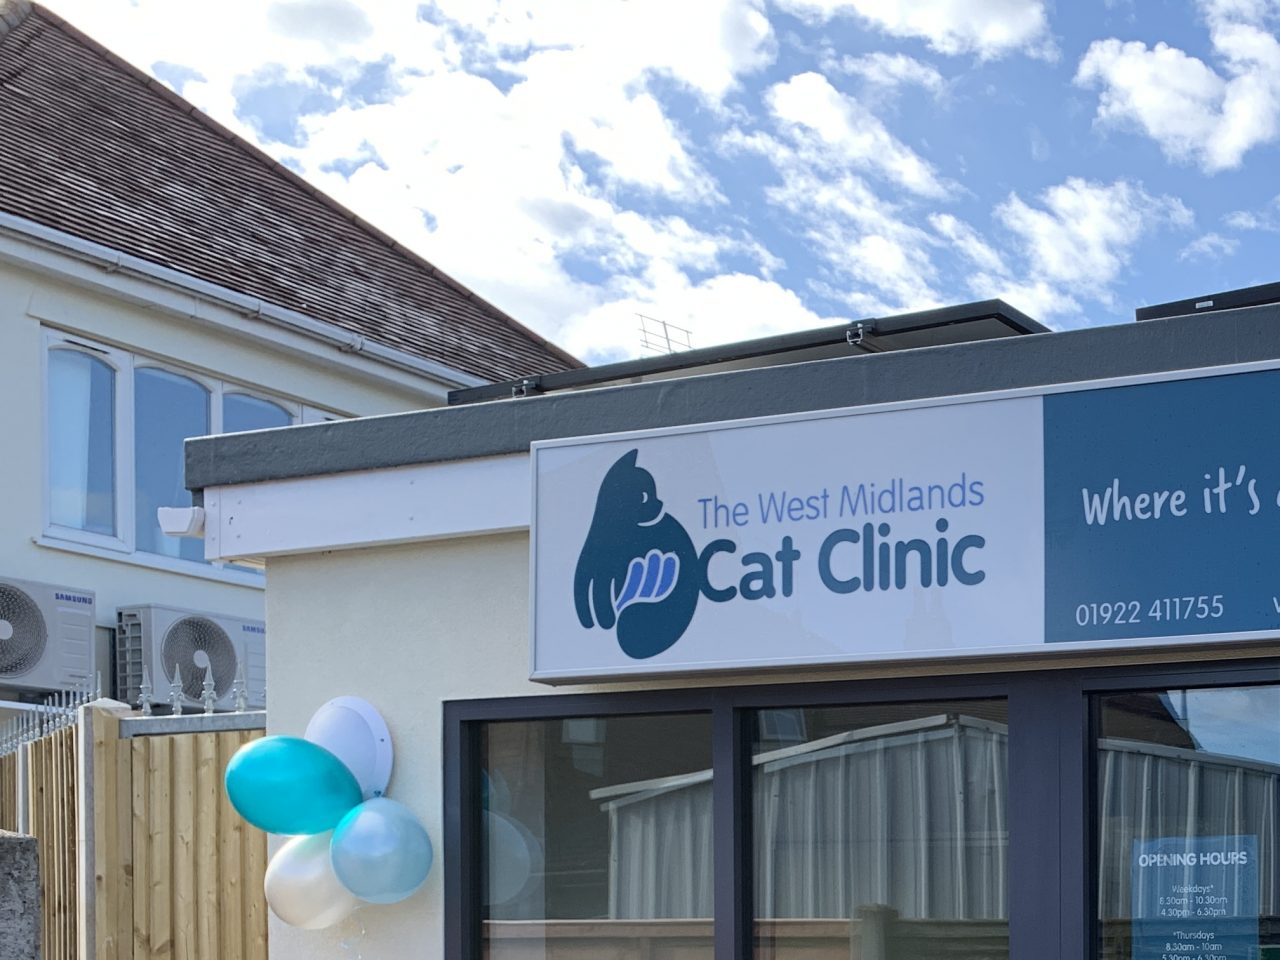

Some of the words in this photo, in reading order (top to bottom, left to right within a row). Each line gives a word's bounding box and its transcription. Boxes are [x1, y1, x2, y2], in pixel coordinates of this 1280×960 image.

[698, 498, 749, 529] The
[758, 488, 829, 524] West
[839, 472, 985, 517] Midlands
[1082, 478, 1187, 526] Where
[1203, 464, 1260, 516] it's
[699, 535, 801, 603] Cat
[818, 518, 986, 594] Clinic
[55, 592, 93, 605] SAMSUNG
[1076, 600, 1141, 627] 01922
[1148, 594, 1225, 623] 411755
[1139, 853, 1196, 867] OPENING
[1200, 851, 1247, 865] HOURS
[1195, 896, 1228, 905] 10.30am
[1160, 908, 1190, 918] 4.30pm
[1197, 907, 1226, 917] 6.30pm
[1166, 943, 1194, 952] 8.30am
[1202, 942, 1222, 951] 10am
